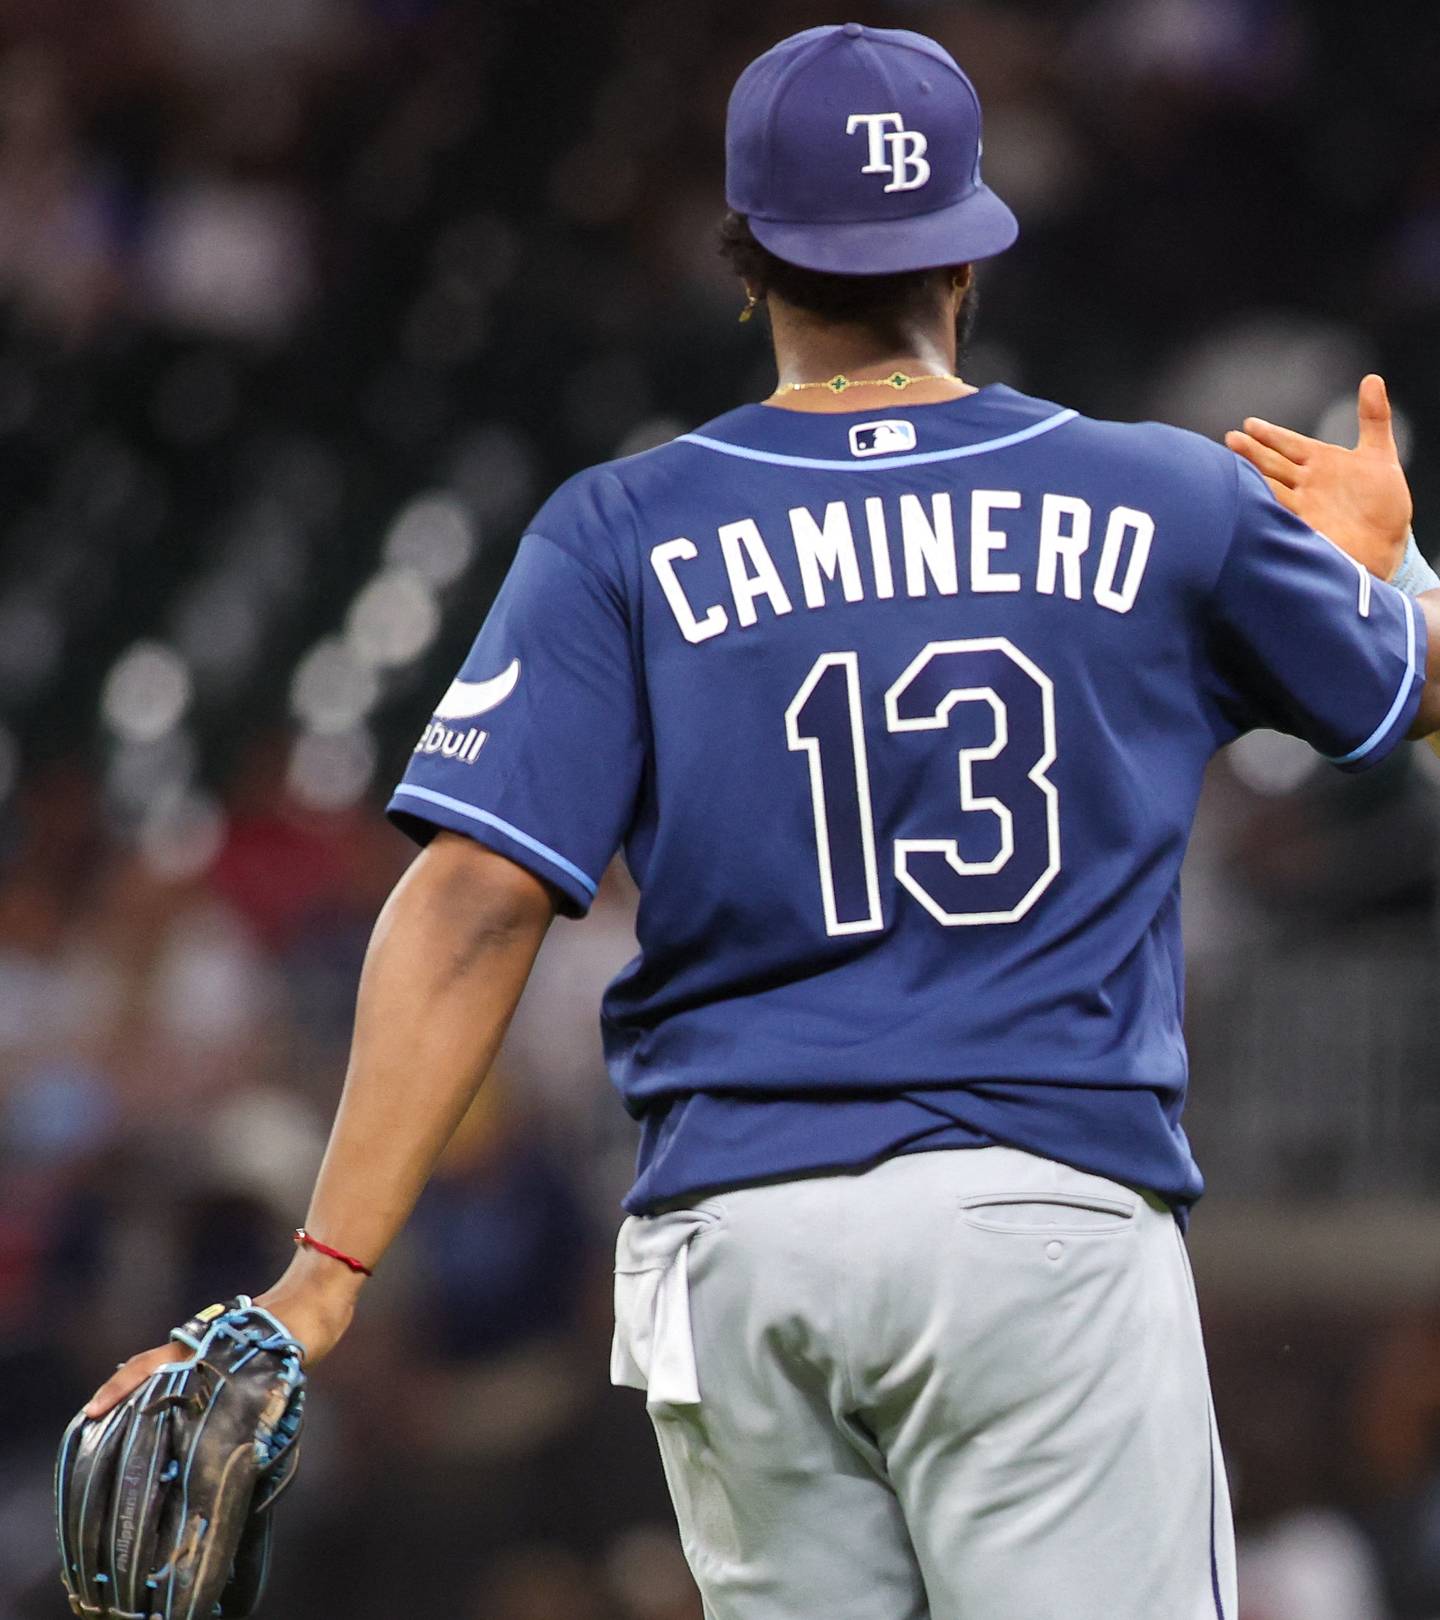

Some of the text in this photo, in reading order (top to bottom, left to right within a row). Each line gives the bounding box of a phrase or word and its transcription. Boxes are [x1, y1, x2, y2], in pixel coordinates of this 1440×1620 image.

[846, 112, 931, 193] TB
[650, 489, 1155, 644] CAMINERO
[785, 637, 1060, 936] 13
